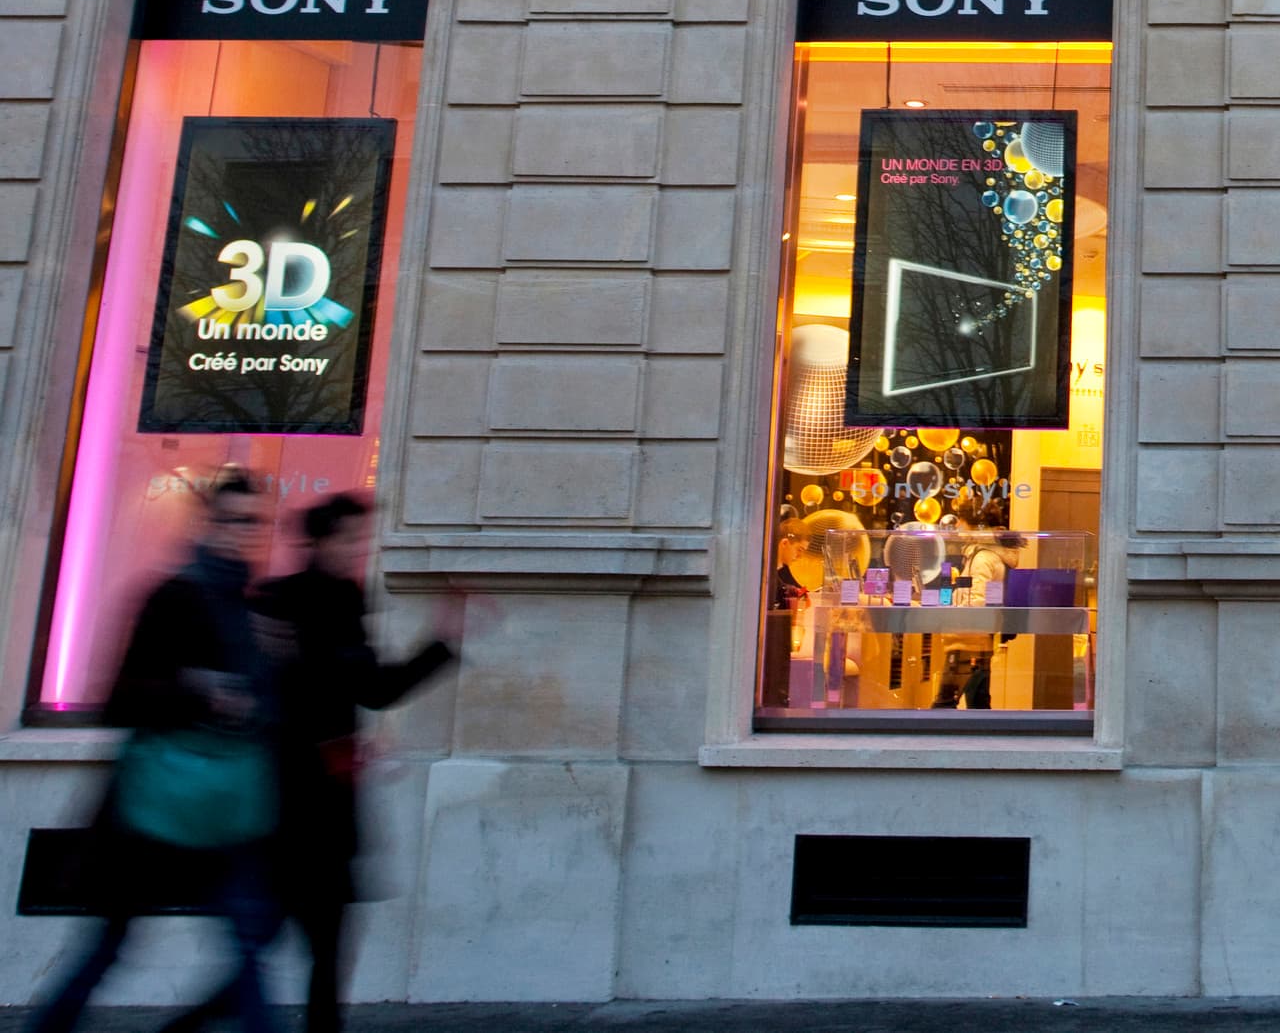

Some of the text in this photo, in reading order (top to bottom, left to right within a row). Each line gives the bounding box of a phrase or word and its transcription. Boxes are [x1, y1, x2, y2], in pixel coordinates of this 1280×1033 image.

[881, 158, 903, 171] UN
[905, 158, 959, 171] MONDE
[961, 158, 981, 171] EN
[880, 172, 960, 186] Créé par Sony.
[211, 239, 331, 312] 3D
[198, 318, 329, 342] Un monde
[188, 351, 330, 376] Créé par Sony
[850, 479, 1033, 509] sony style
